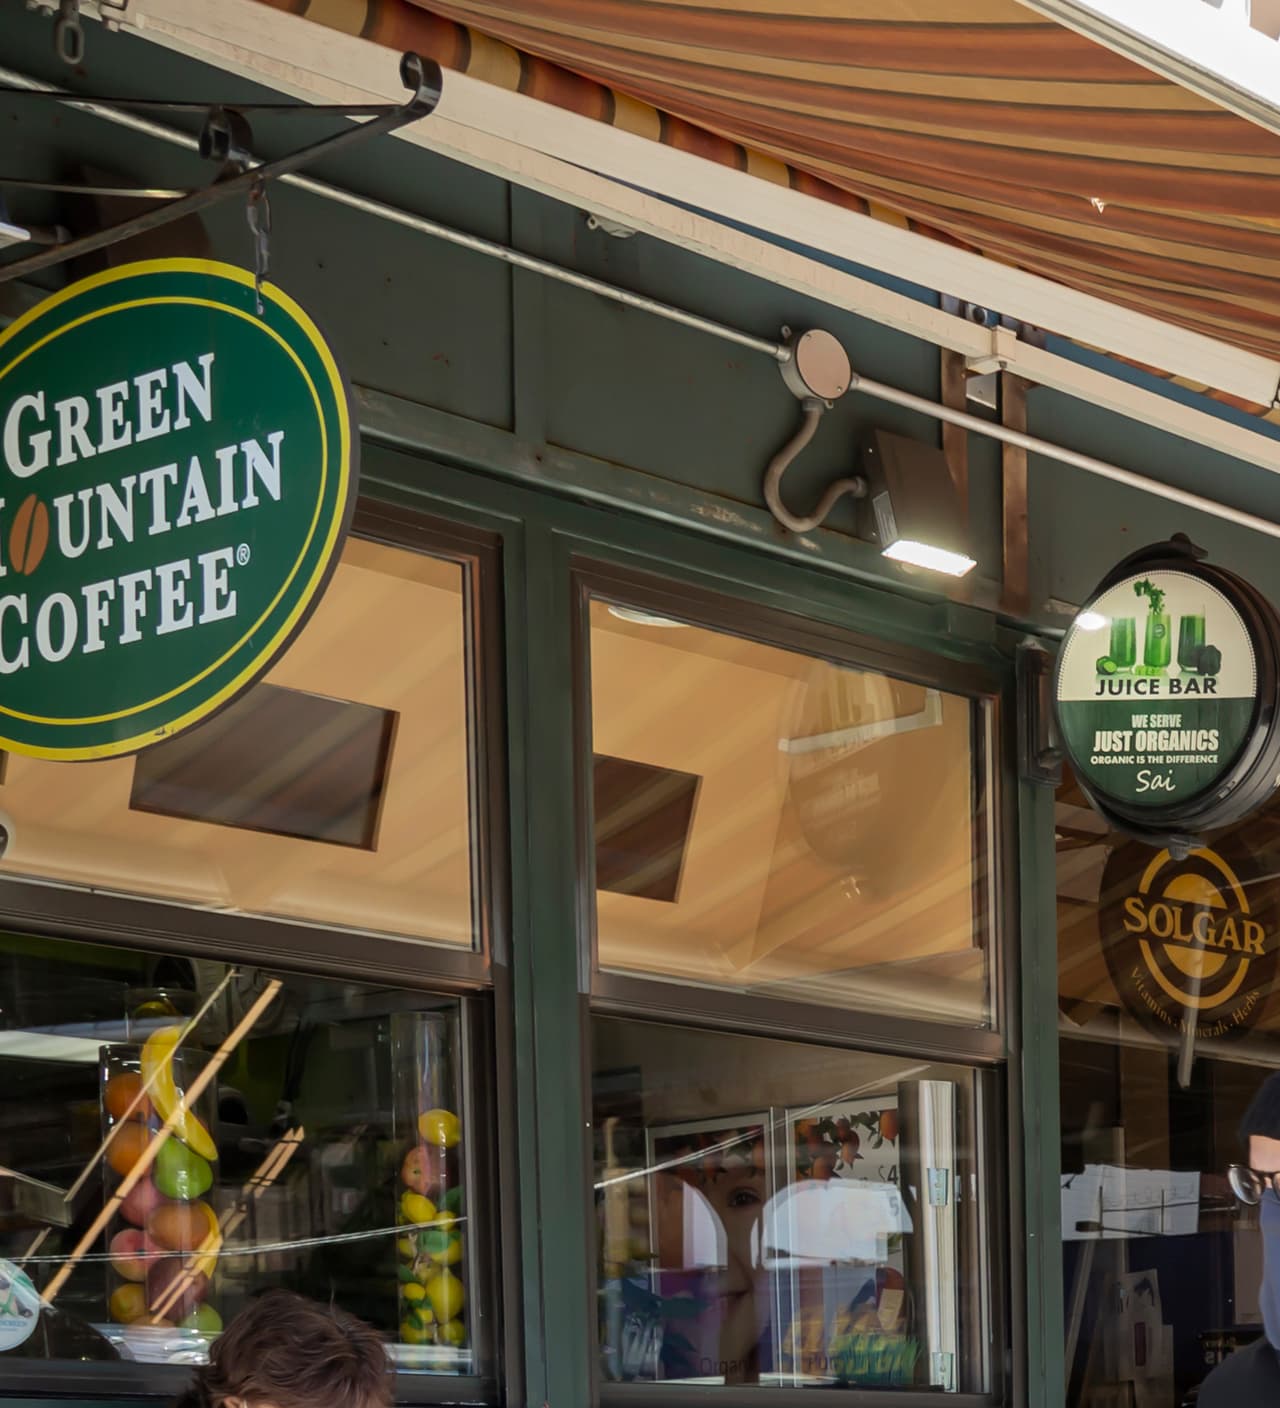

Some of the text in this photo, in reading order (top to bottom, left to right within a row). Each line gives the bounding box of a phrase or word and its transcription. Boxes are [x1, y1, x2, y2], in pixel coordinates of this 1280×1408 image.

[3, 353, 216, 478] GREEN
[1096, 677, 1217, 695] JUICE BAR
[1131, 714, 1182, 728] WE SERVE
[1093, 730, 1219, 752] JUST ORGANICS
[1090, 755, 1218, 764] ORGANIC IS THE DIFFERENCE
[1135, 769, 1176, 792] Sai
[1123, 897, 1266, 955] SOLGAR
